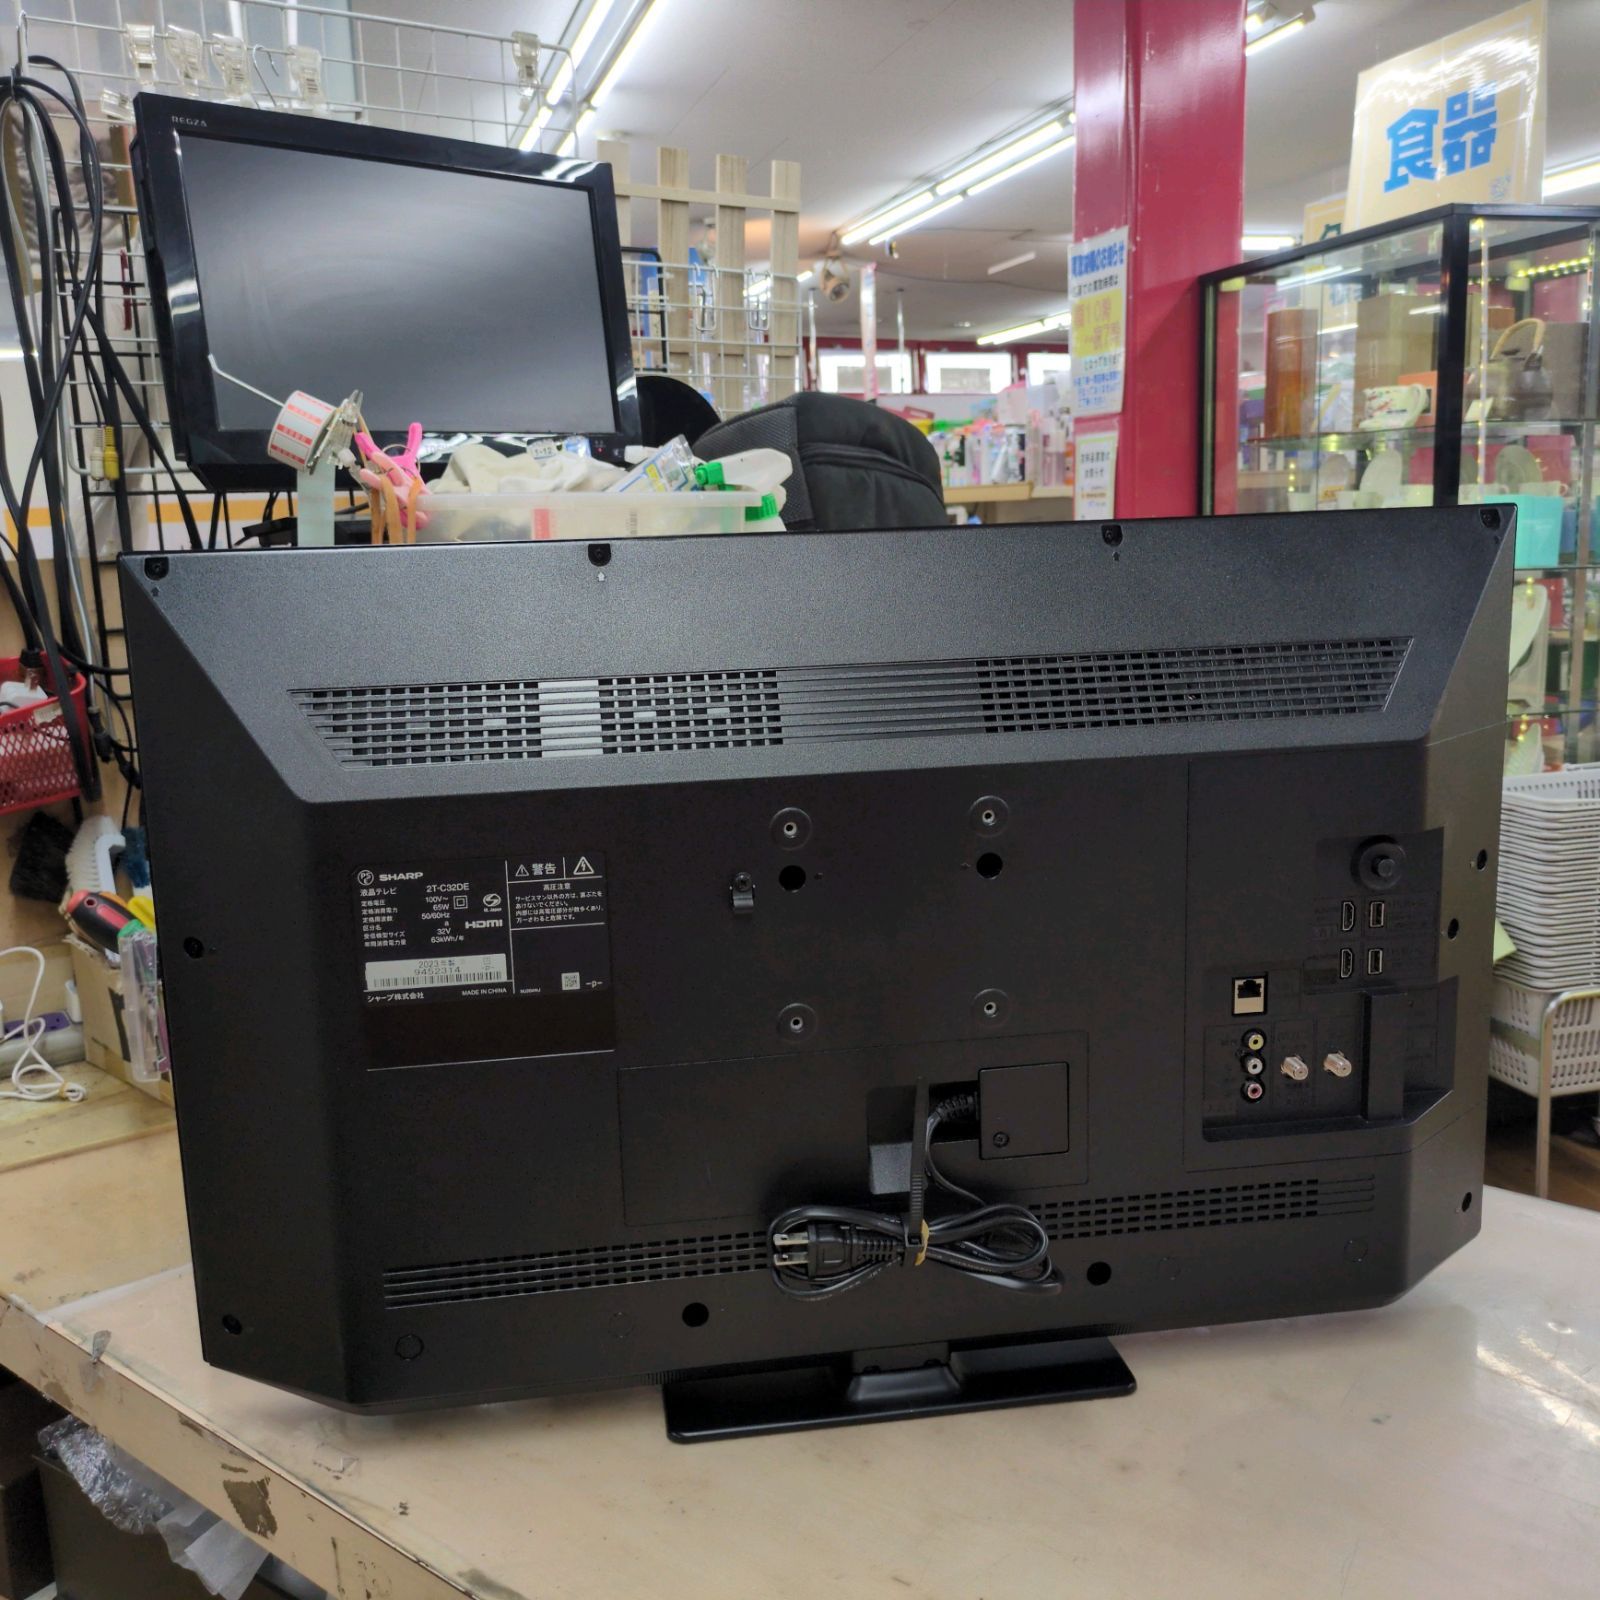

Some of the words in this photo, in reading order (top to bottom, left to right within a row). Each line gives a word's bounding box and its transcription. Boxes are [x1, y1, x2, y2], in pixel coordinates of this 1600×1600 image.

[171, 115, 208, 127] REGZA
[1383, 84, 1497, 193] 食器
[532, 863, 556, 876] 警告
[379, 872, 424, 881] SHARP
[360, 887, 398, 897] 液晶テレビ
[426, 883, 470, 893] 2T-C32DE
[421, 912, 450, 920] 50/60Hz
[465, 920, 503, 929] HDMI
[367, 991, 425, 1003] シャープ株式会社
